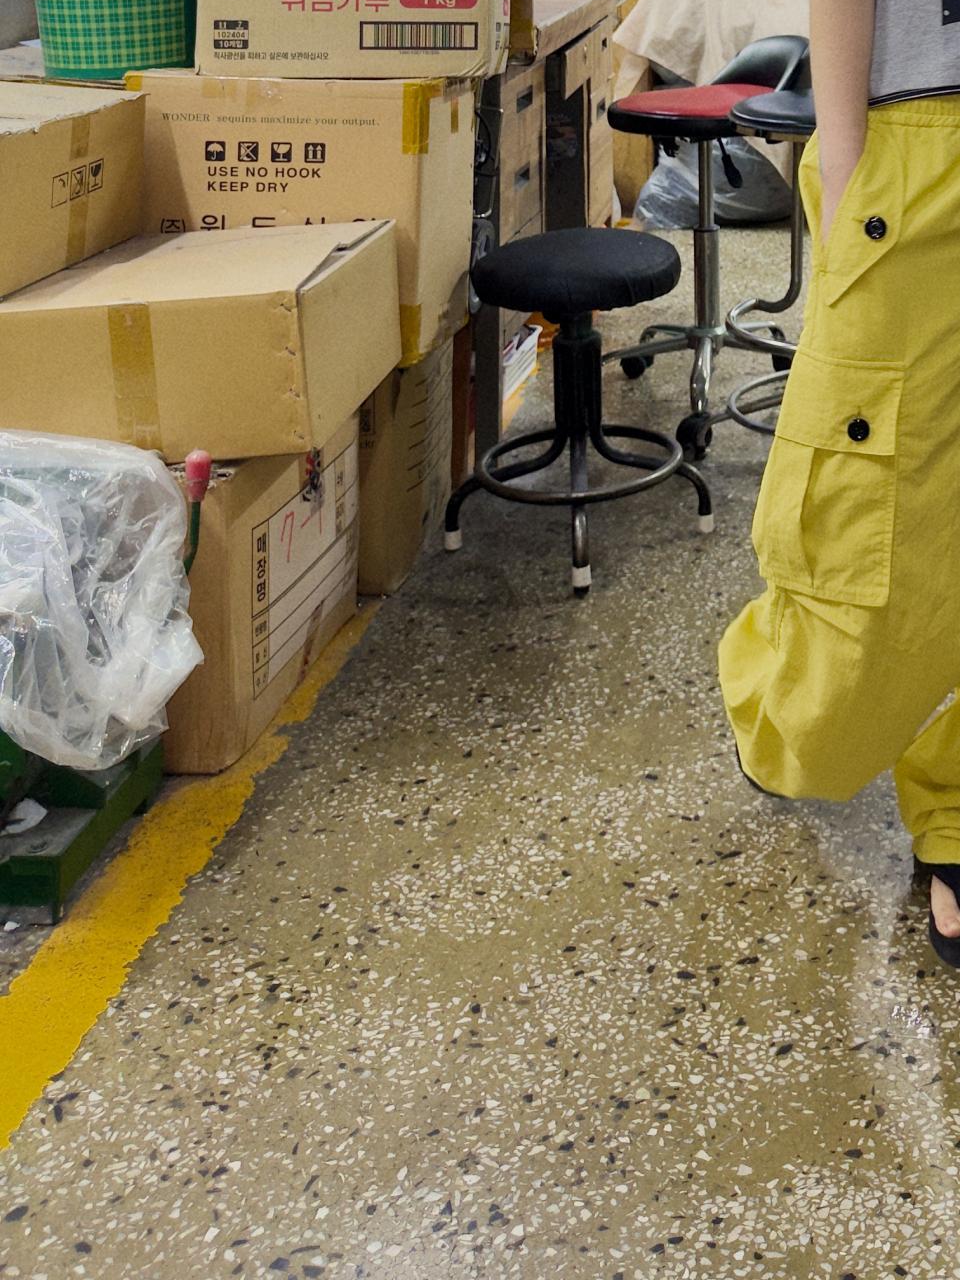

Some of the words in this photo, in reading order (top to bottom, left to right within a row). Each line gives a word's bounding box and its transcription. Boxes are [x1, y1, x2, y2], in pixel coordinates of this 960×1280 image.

[161, 112, 210, 122] WONDER
[216, 114, 257, 125] sequins
[260, 115, 312, 125] maximize
[314, 117, 338, 126] your
[207, 166, 239, 177] USE
[245, 167, 269, 178] NO
[275, 167, 322, 179] HOOK
[207, 181, 249, 192] KEEP
[256, 182, 290, 193] DRY
